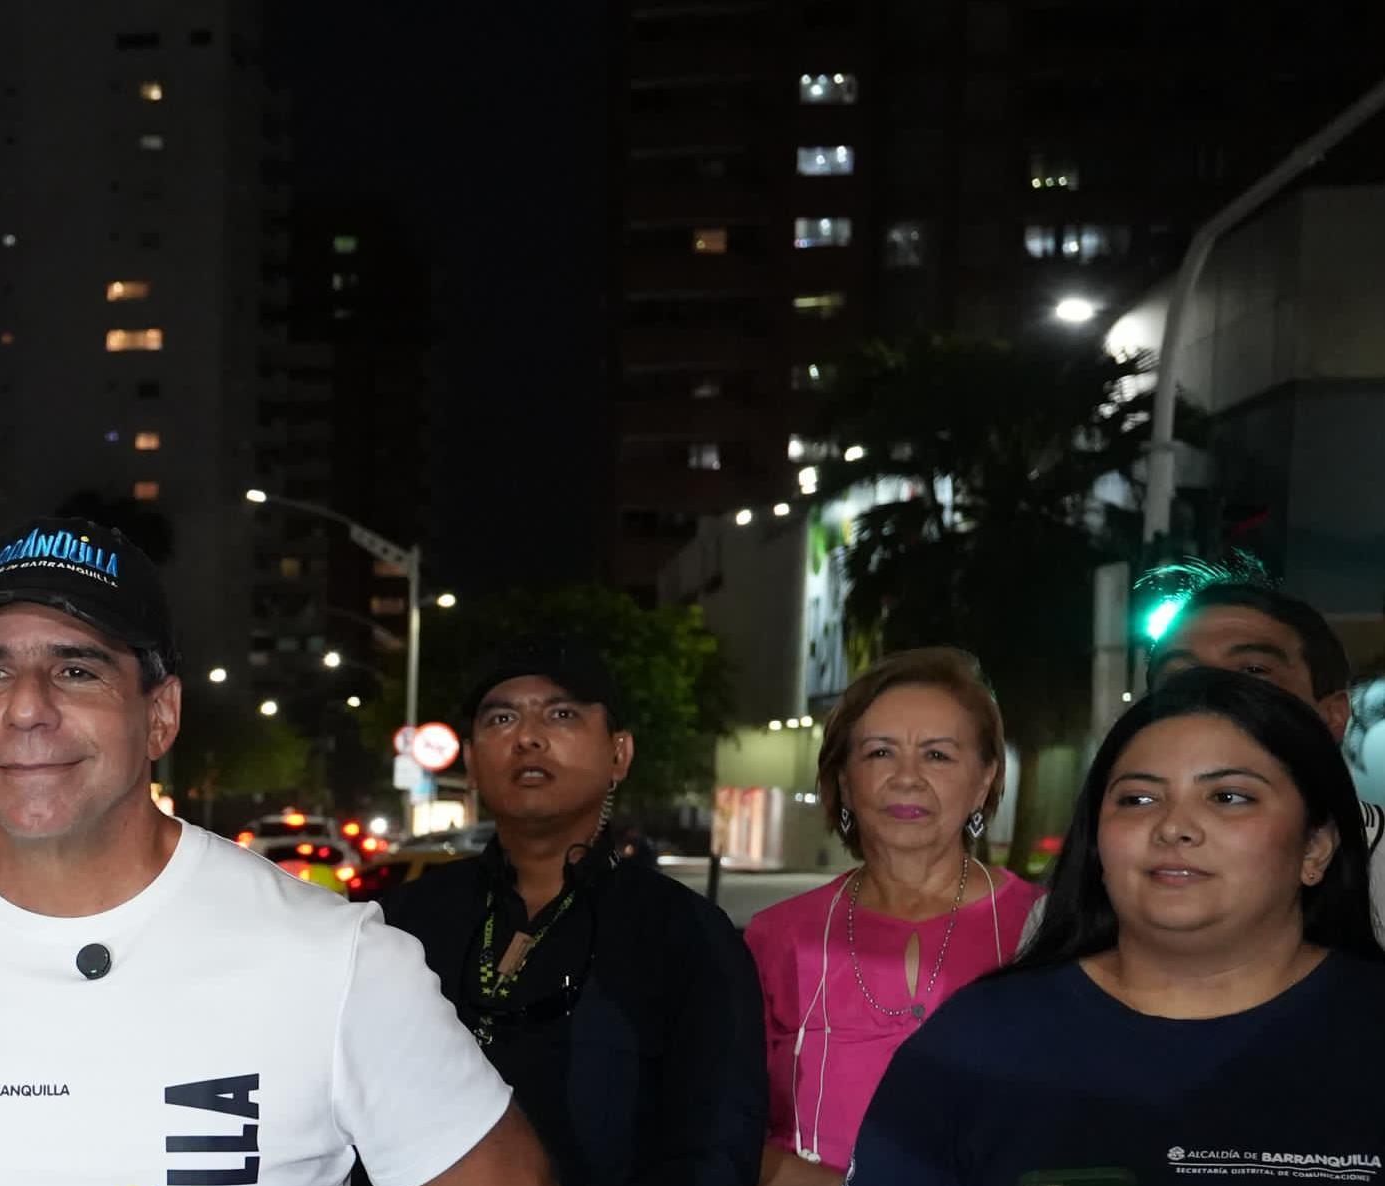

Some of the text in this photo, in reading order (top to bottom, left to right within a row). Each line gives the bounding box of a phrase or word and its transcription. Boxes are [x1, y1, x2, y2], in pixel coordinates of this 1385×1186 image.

[1187, 1149, 1382, 1168] ALCALDÍA DE BARRANQUILLA
